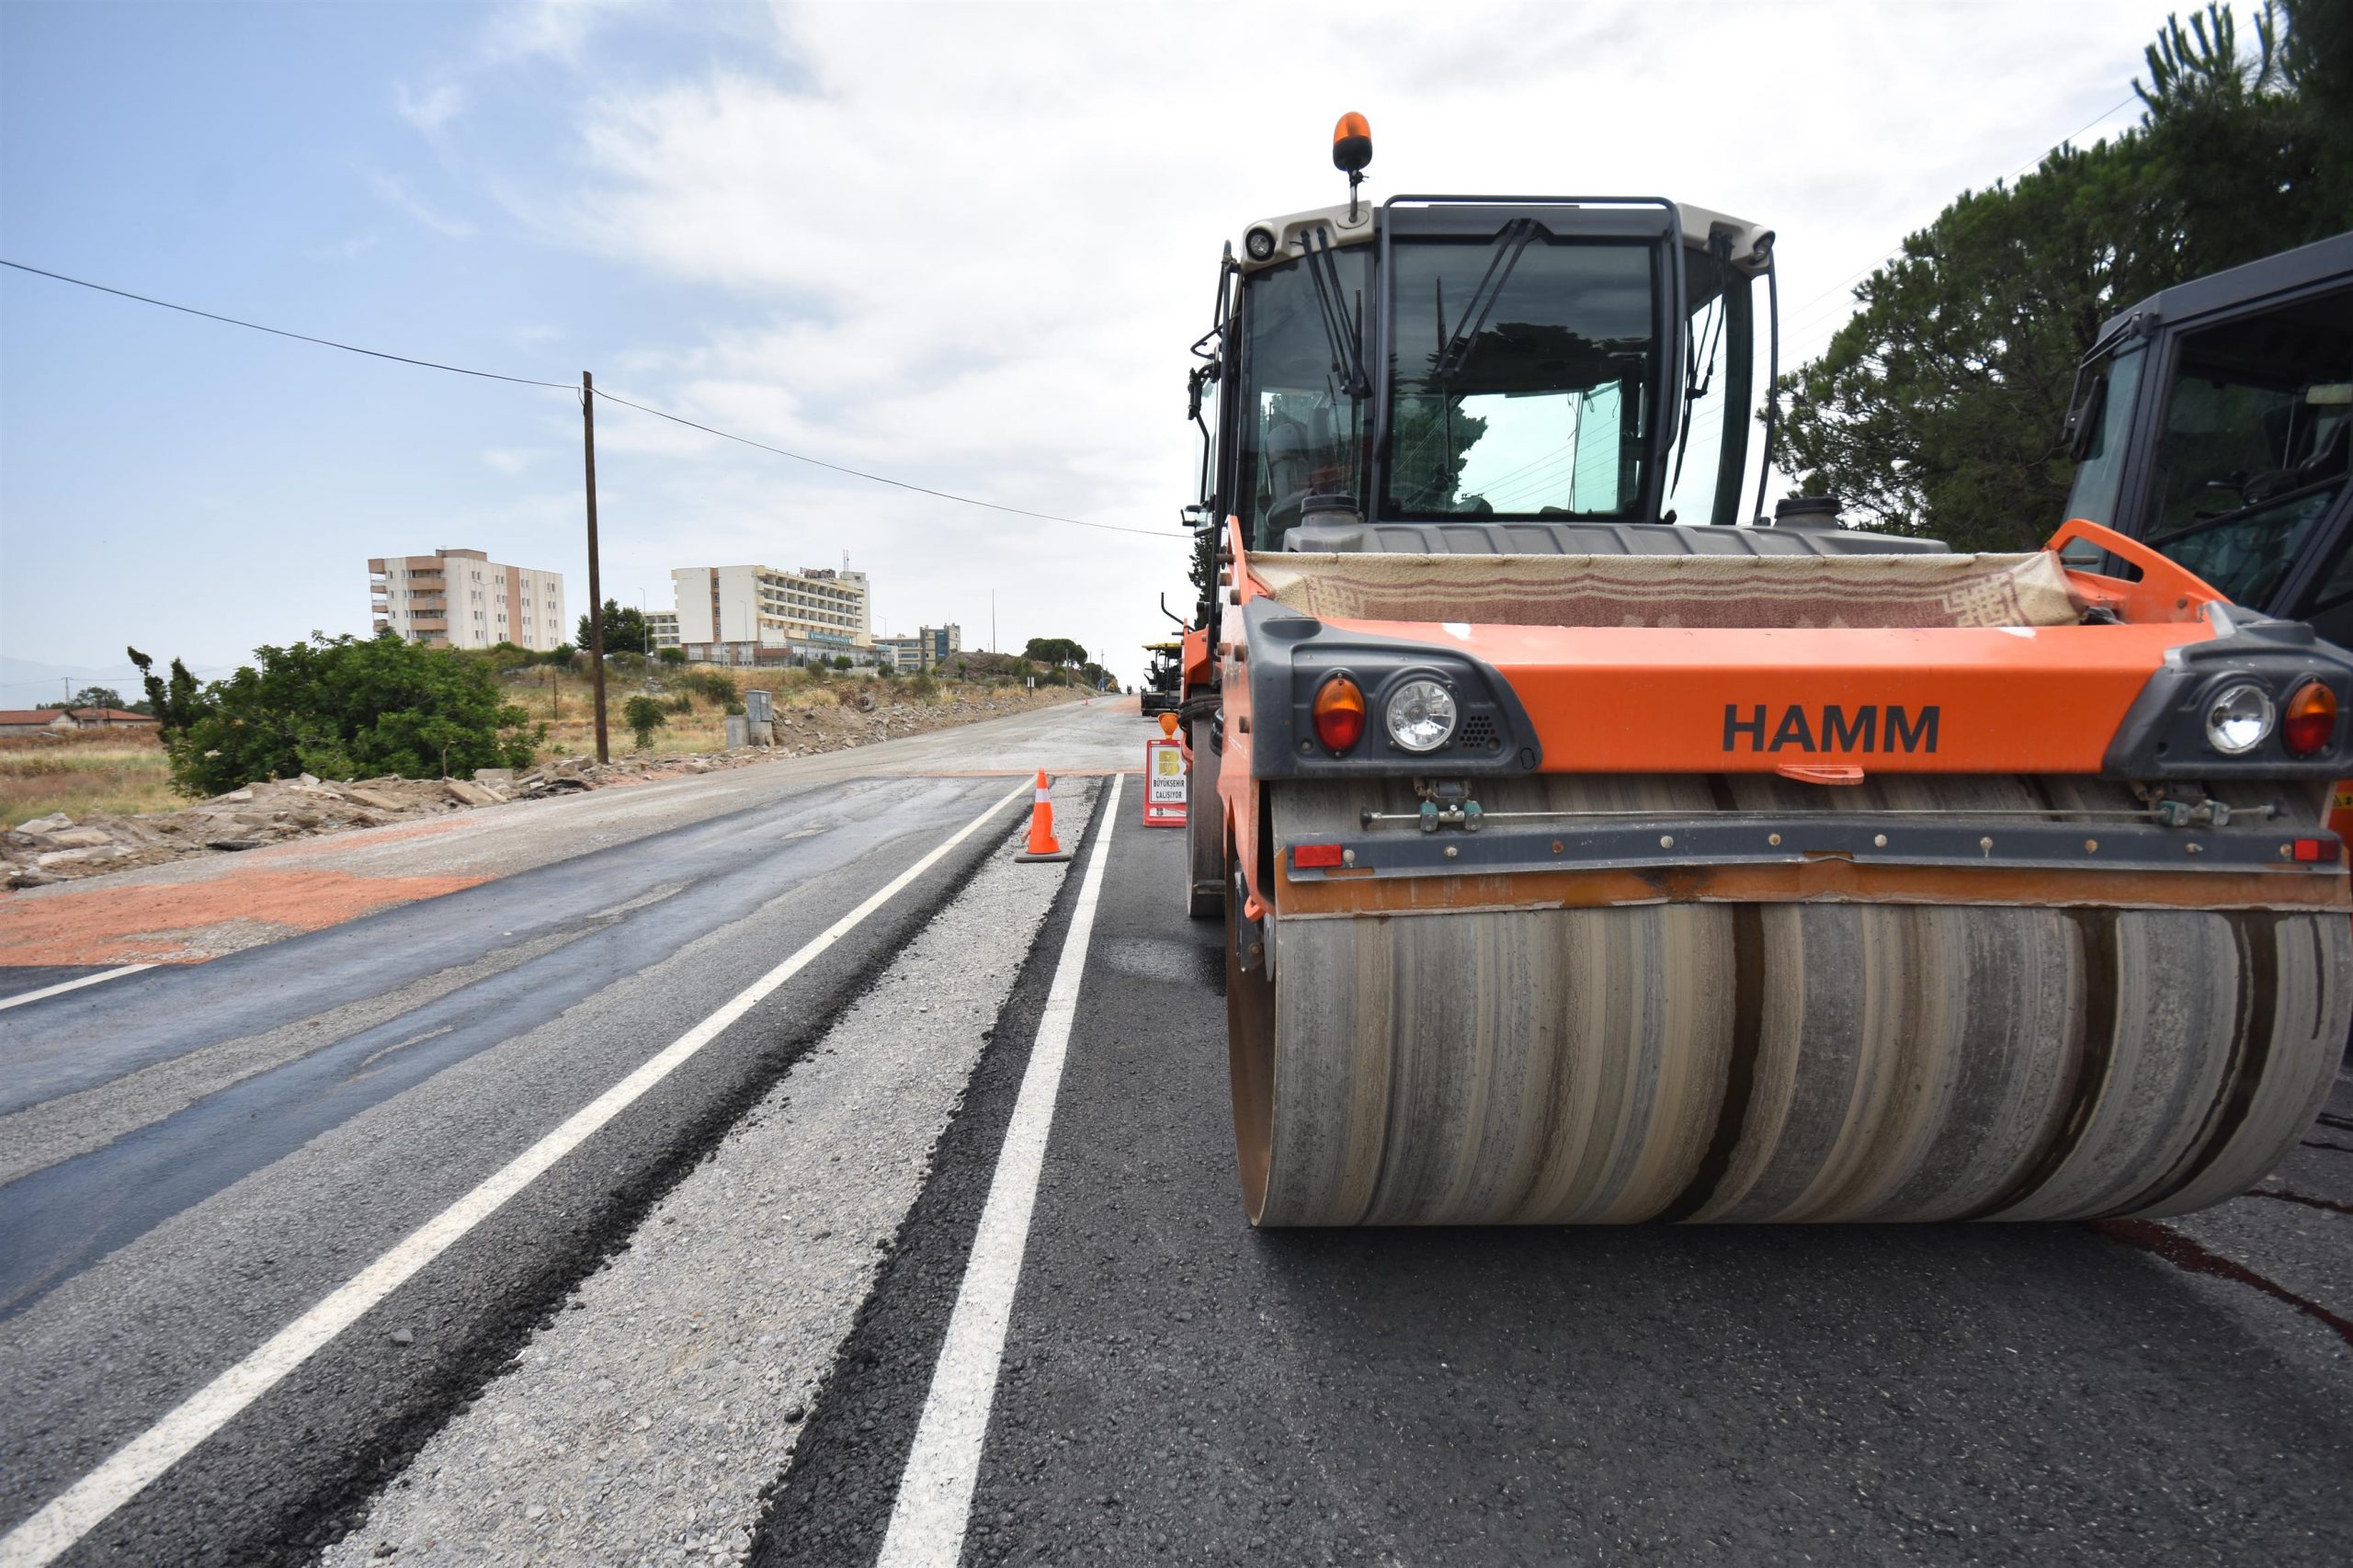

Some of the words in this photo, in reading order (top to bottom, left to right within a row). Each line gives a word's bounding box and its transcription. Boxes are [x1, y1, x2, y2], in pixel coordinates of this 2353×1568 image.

[1722, 704, 1940, 753] HAMM
[1154, 778, 1185, 790] BÜYÜKŞEHİR
[1155, 790, 1182, 801] ÇALIŞIYOR
